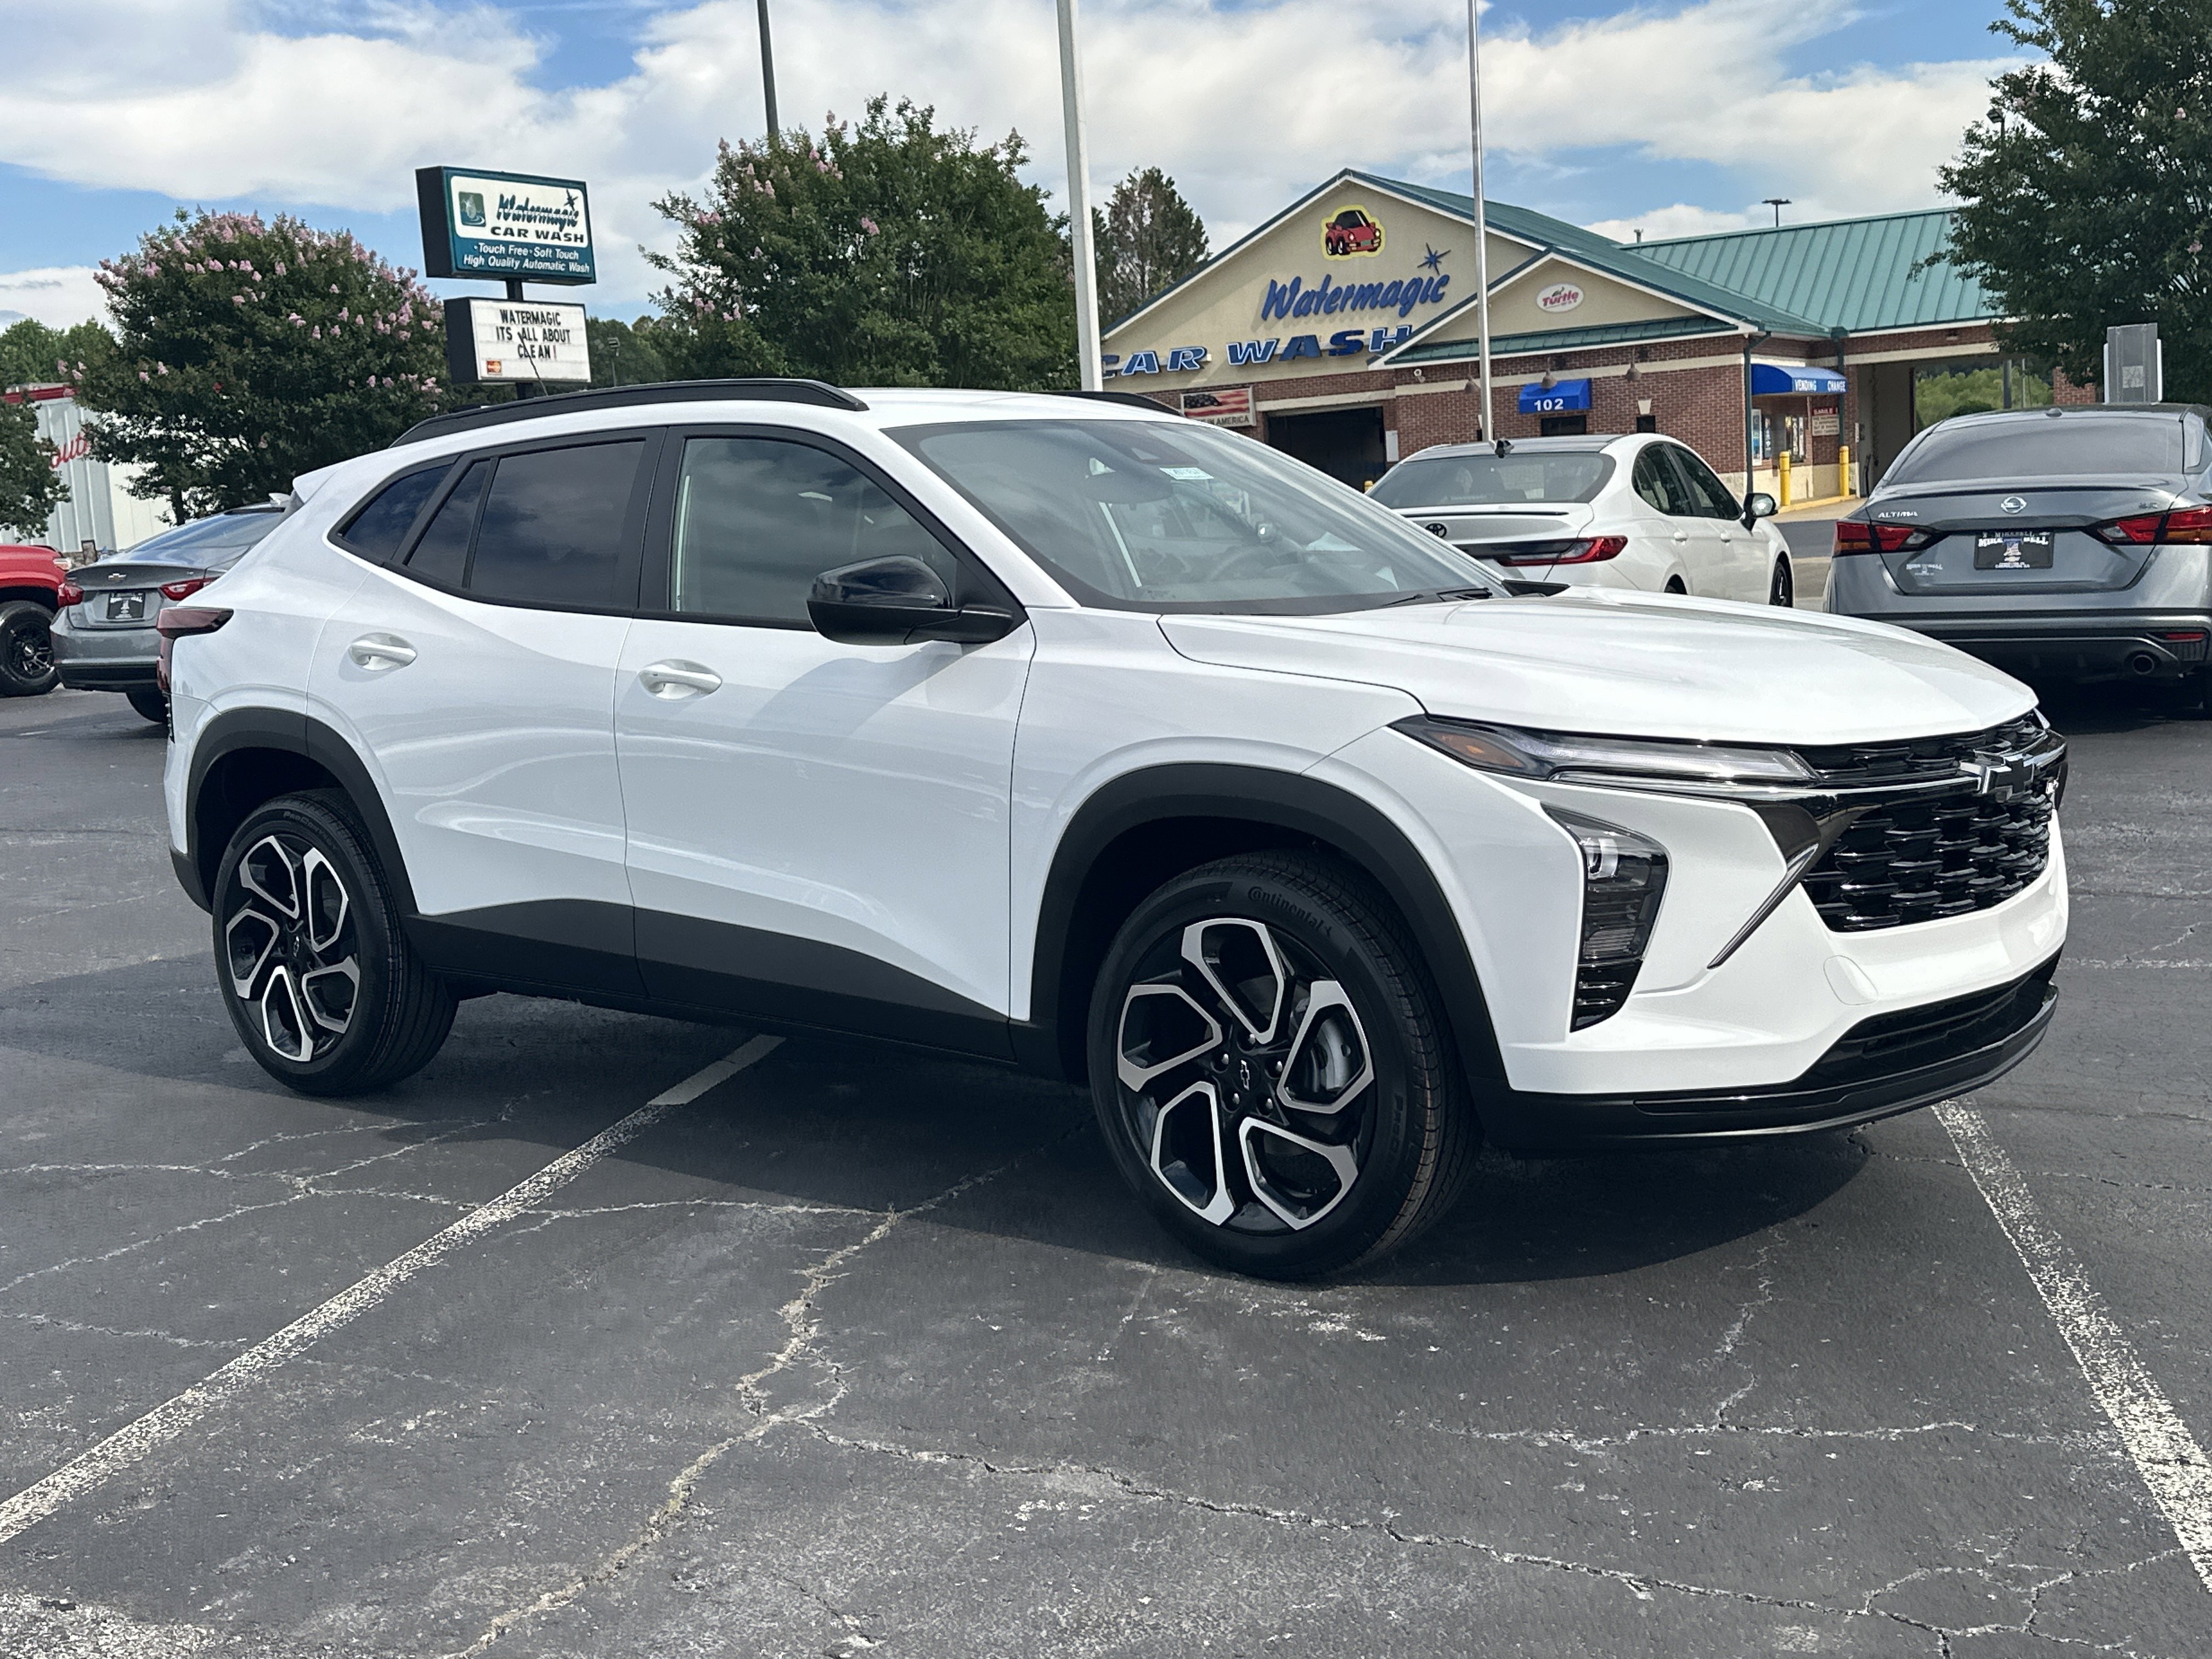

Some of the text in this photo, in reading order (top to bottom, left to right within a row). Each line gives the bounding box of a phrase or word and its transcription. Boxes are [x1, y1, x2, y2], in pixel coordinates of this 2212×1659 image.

[496, 194, 579, 232] Watermagic
[491, 227, 584, 243] CAR WASH
[509, 245, 529, 256] Free
[533, 247, 552, 258] Soft
[555, 249, 579, 260] Touch
[464, 255, 590, 273] High Quality Automatic Wash
[1261, 274, 1451, 321] Watermagic
[500, 309, 561, 326] WATERMAGIC
[496, 326, 571, 344] ITS ALL ABOUT
[1226, 324, 1413, 366] WASH
[1534, 398, 1564, 411] 102
[1216, 415, 1249, 426] AMERICA
[1248, 887, 1324, 930] Continental
